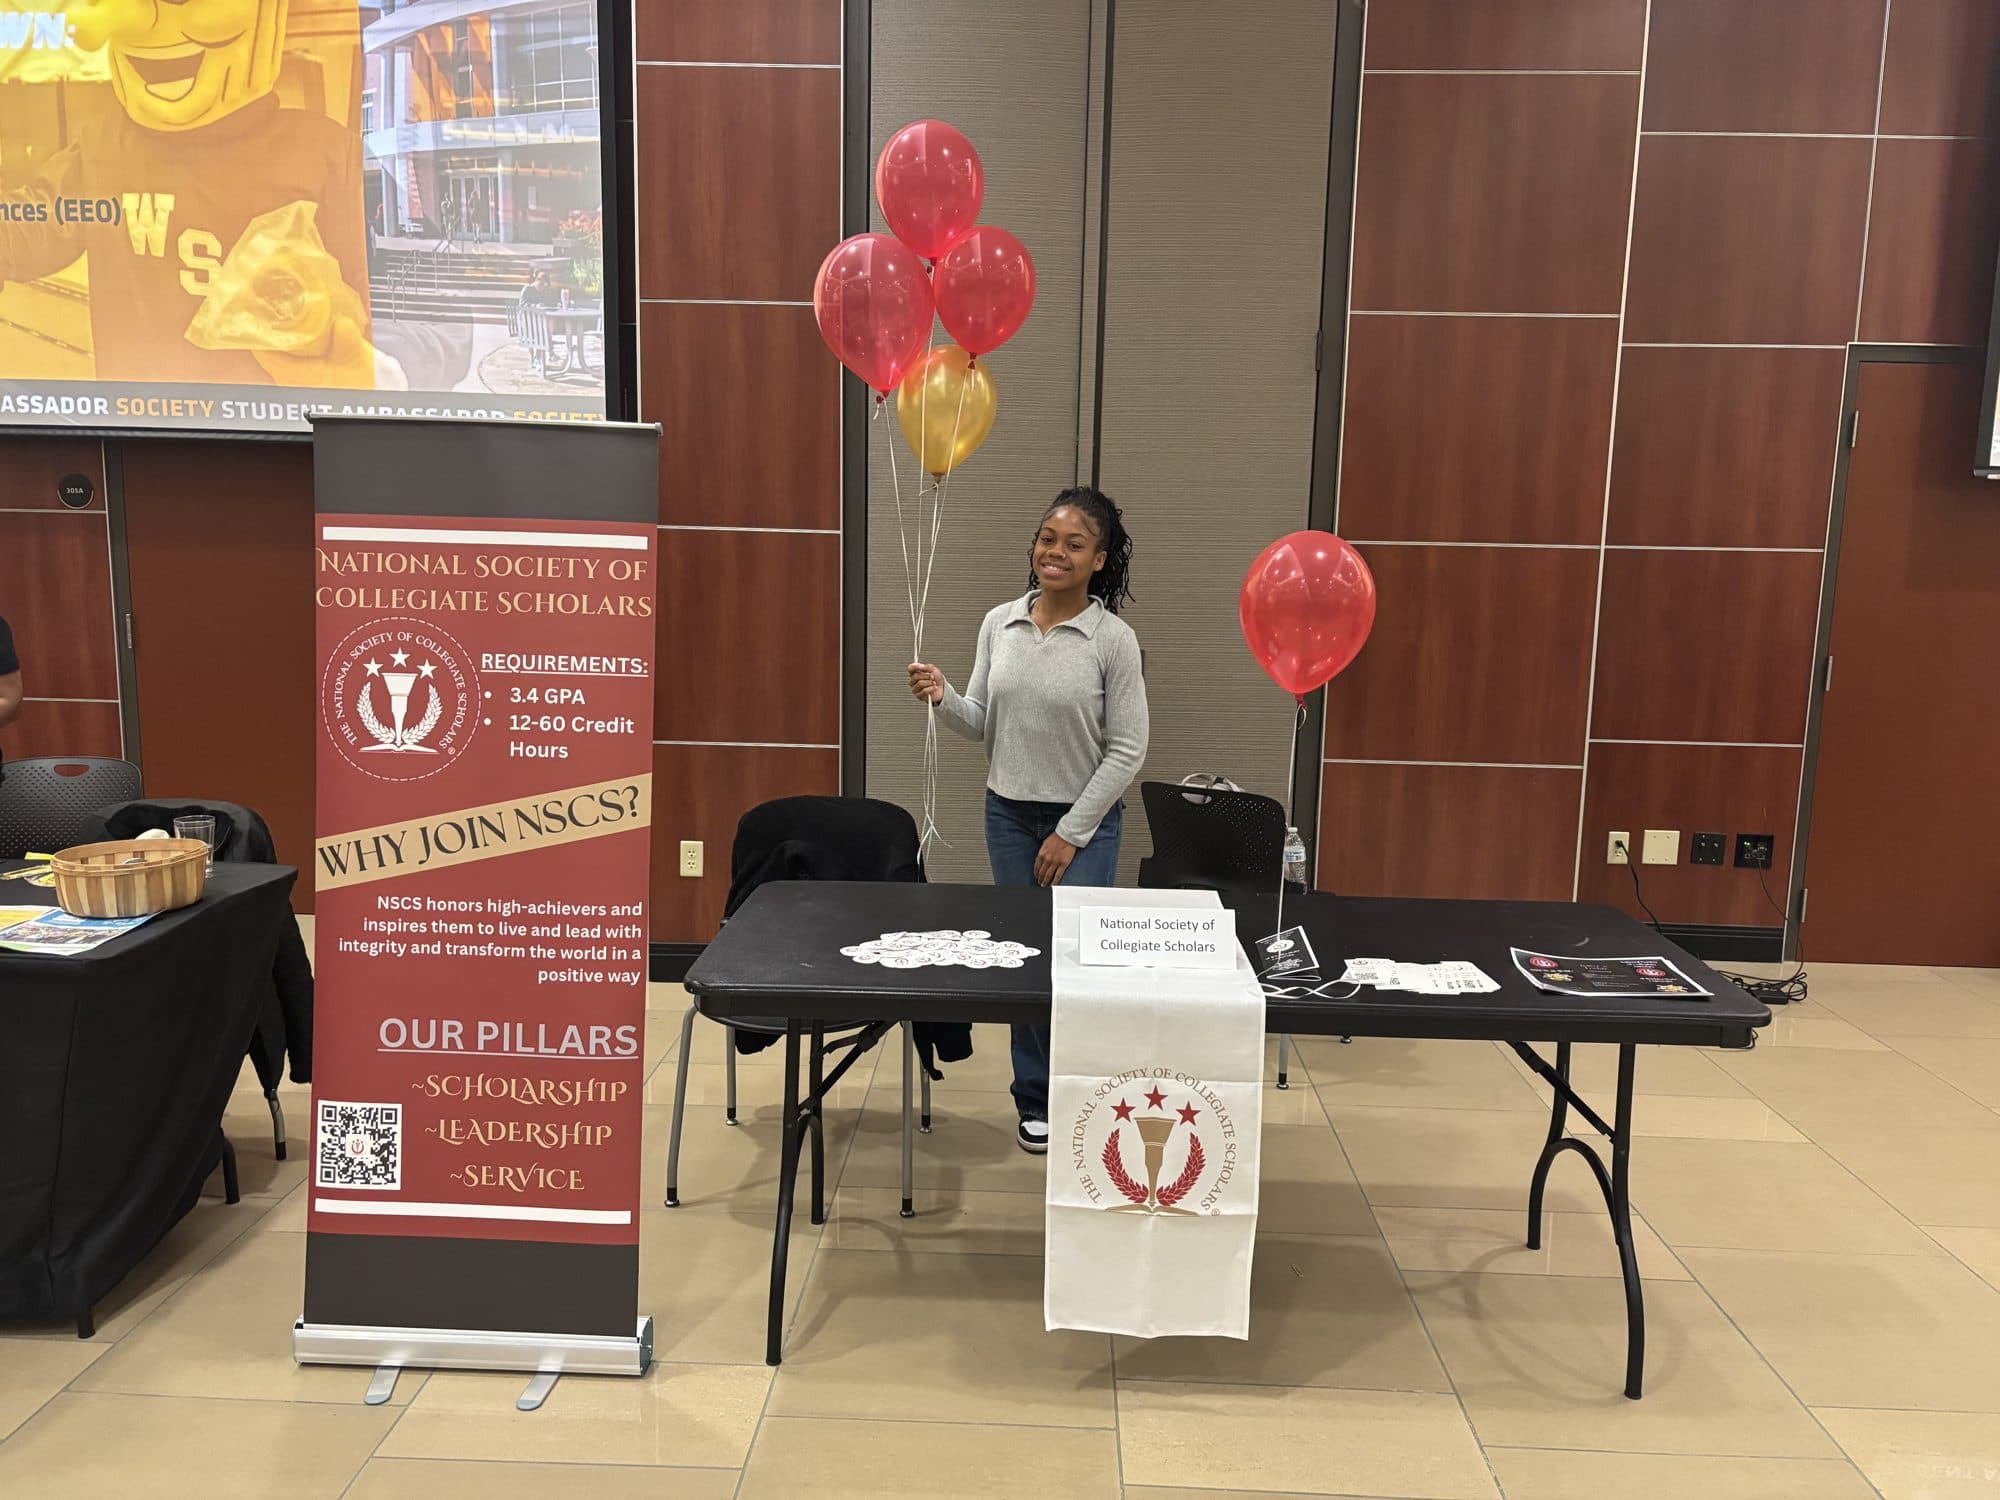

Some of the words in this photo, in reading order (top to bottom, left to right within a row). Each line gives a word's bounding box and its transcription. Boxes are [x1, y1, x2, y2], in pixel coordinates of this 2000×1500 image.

[54, 196, 121, 226] (EEO)
[0, 395, 109, 415] ASSADOR
[116, 398, 214, 418] SOCIETY
[316, 547, 467, 576] NATIONAL
[474, 554, 600, 579] SOCIETY
[608, 559, 648, 581] OF
[316, 586, 489, 613] COLLEGIATE
[496, 591, 652, 617] SCHOLARS
[350, 632, 393, 660] SOCIETY
[397, 631, 413, 642] OF
[415, 635, 466, 689] COLLEGIATE
[481, 653, 649, 675] REQUIREMENTS:
[335, 660, 352, 719] NATIONAL
[510, 687, 539, 704] 3.4
[544, 688, 586, 705] GPA
[340, 722, 358, 745] THE
[509, 714, 566, 732] 12-60
[571, 716, 635, 734] Credit
[510, 741, 569, 759] Hours
[318, 830, 407, 877] WHY
[418, 811, 507, 865] JOIN
[514, 784, 640, 841] NSCS?
[377, 895, 422, 911] NSCS
[426, 896, 483, 913] honors
[487, 898, 607, 917] high-achievers
[611, 901, 643, 917] and
[363, 917, 428, 935] inspires
[431, 919, 473, 935] them
[477, 921, 494, 935] to
[498, 921, 527, 937] live
[531, 922, 561, 938] and
[565, 923, 601, 938] lead
[605, 923, 642, 939] with
[1100, 917, 1151, 930] National
[1154, 918, 1199, 933] Society
[1202, 918, 1216, 931] of
[338, 938, 407, 957] integrity
[410, 940, 441, 955] and
[445, 941, 525, 958] transform
[529, 944, 556, 959] the
[560, 944, 607, 960] world
[612, 945, 628, 960] in
[631, 948, 642, 960] a
[1100, 938, 1161, 954] Collegiate
[1164, 940, 1216, 953] Scholars
[537, 967, 604, 985] positive
[607, 971, 641, 986] way
[378, 1018, 464, 1050] OUR
[477, 1021, 638, 1056] PILLARS
[1094, 1067, 1149, 1100] SOCIETY
[1153, 1067, 1172, 1079] OF
[1175, 1072, 1236, 1139] COLLEGIATE
[1072, 1101, 1098, 1170] NATIONAL
[1080, 1174, 1103, 1204] THE
